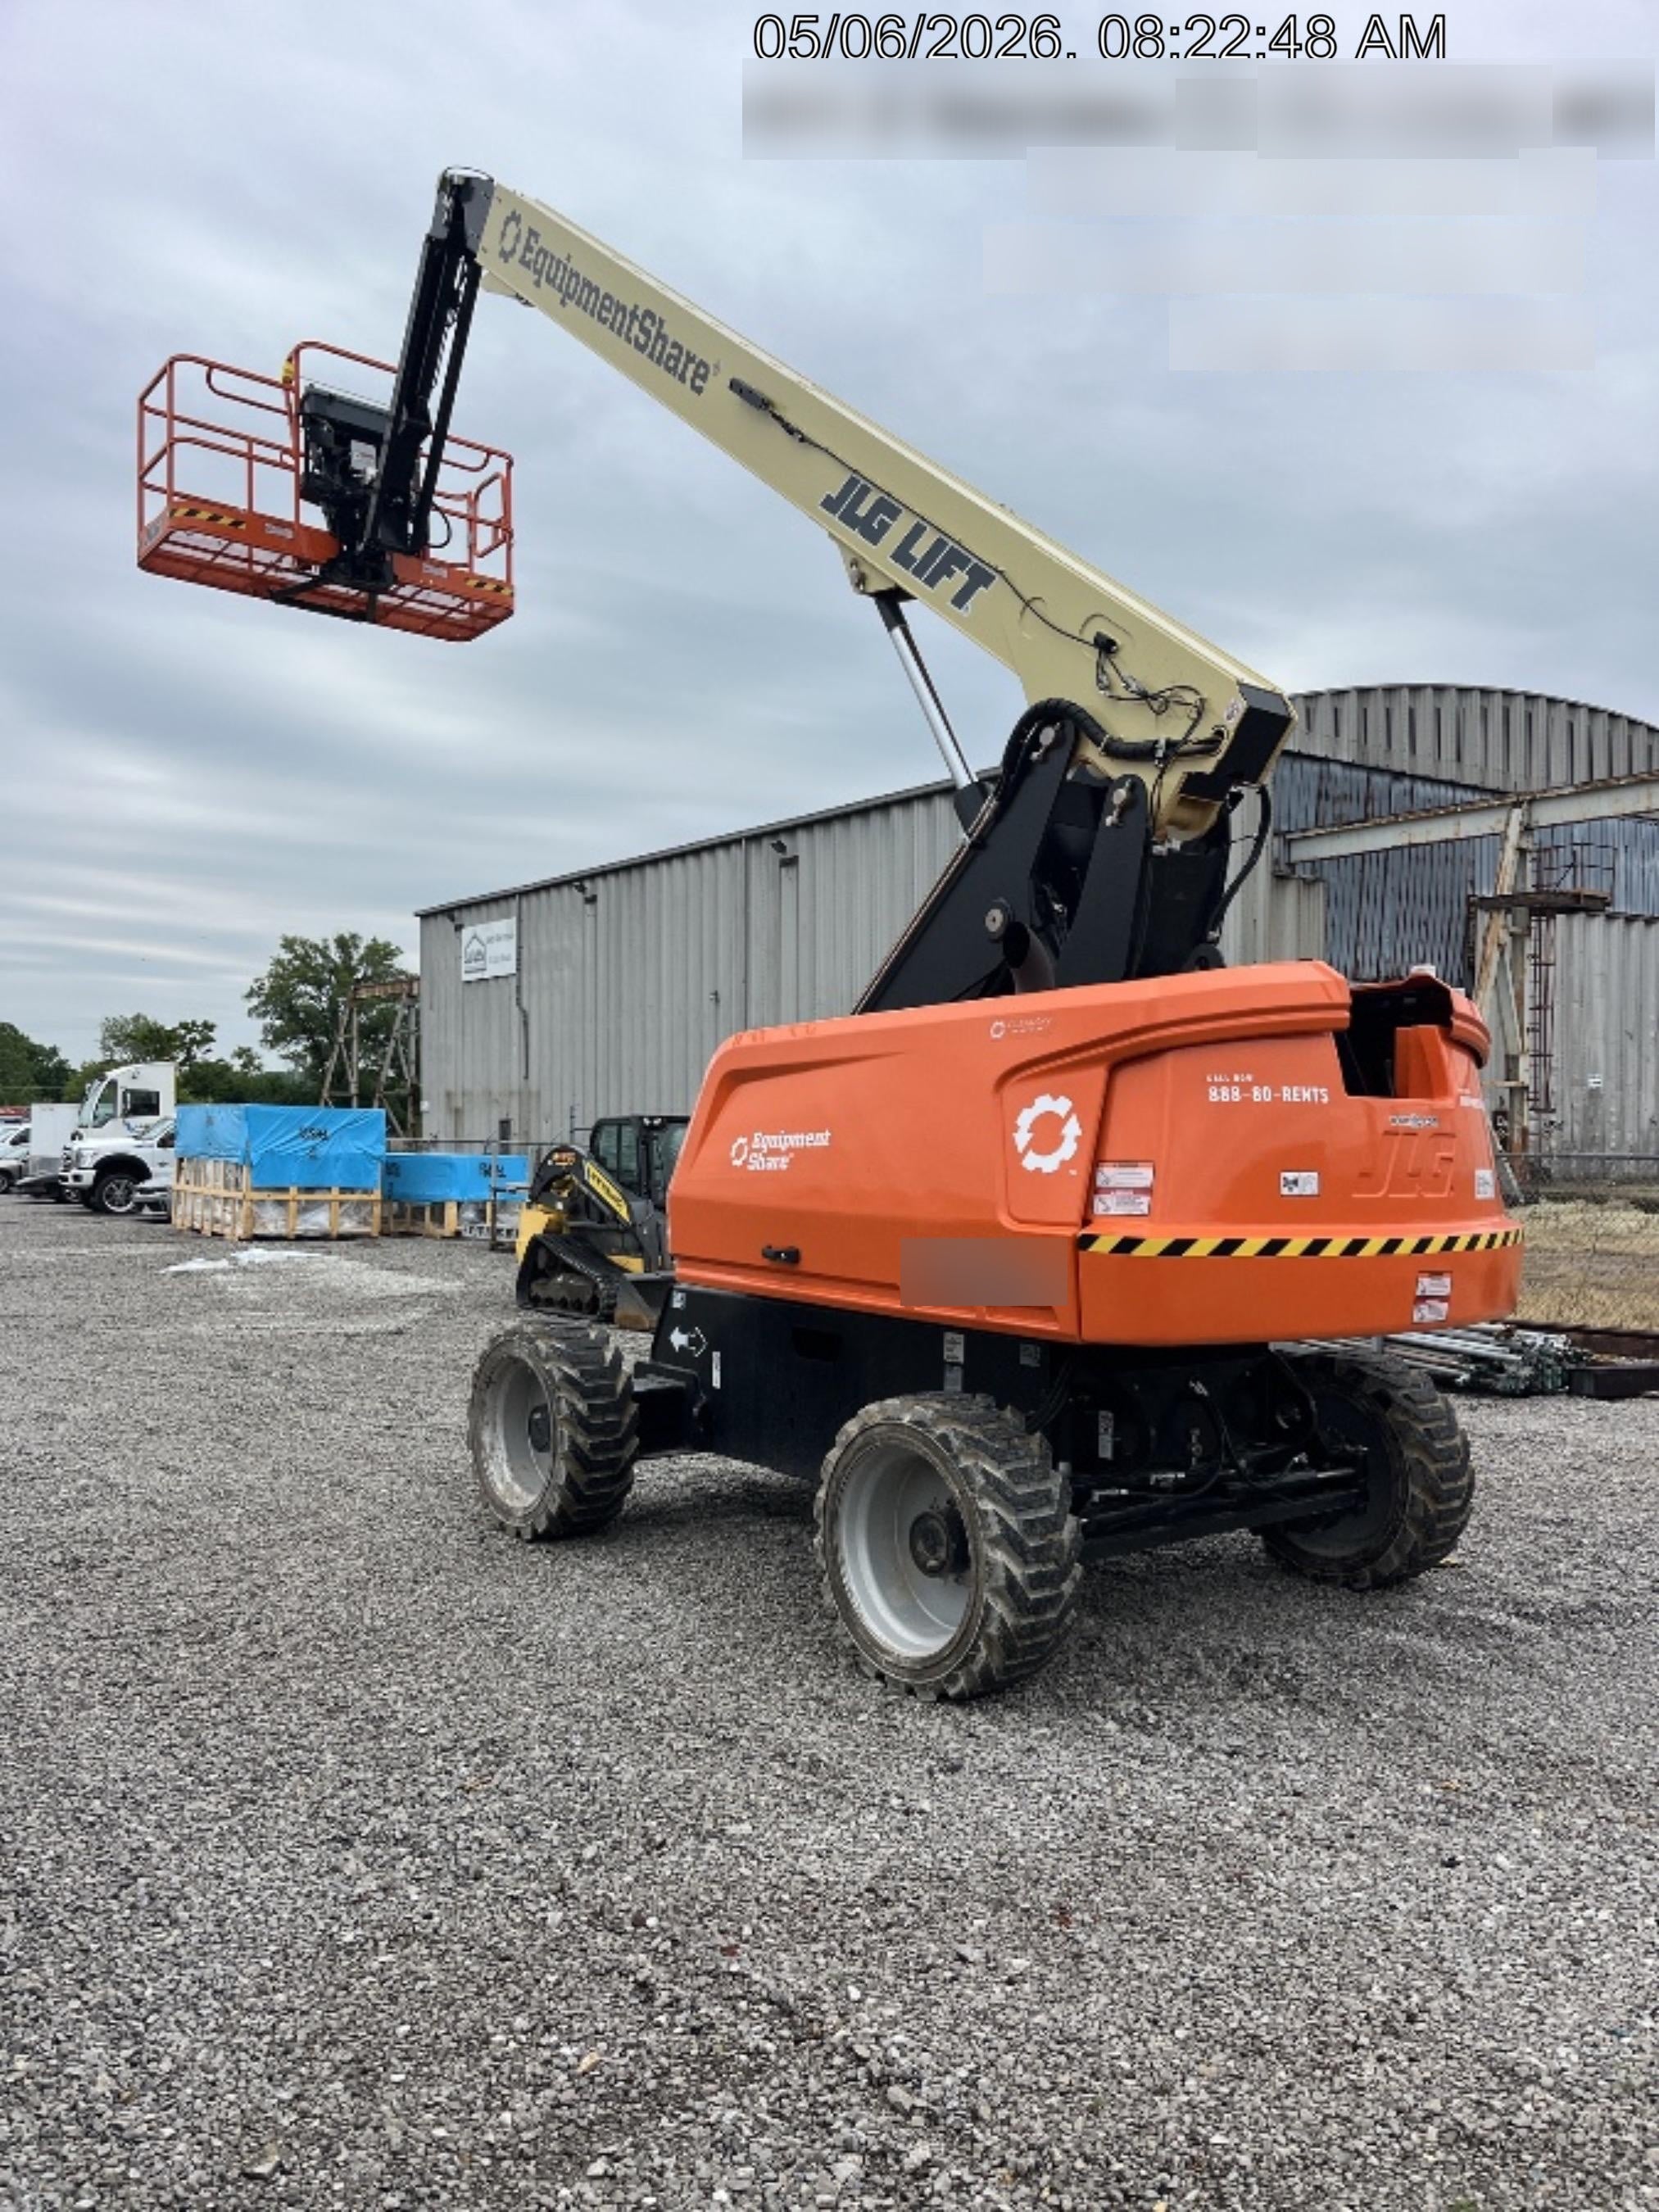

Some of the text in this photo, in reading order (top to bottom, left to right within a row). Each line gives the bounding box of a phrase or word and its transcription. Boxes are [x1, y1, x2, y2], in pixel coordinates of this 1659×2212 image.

[518, 226, 711, 396] EquipmentShare
[819, 474, 998, 612] JLG LIFT
[746, 1152, 791, 1172] Share
[751, 1129, 831, 1153] Equipment
[1352, 1130, 1457, 1198] JLG
